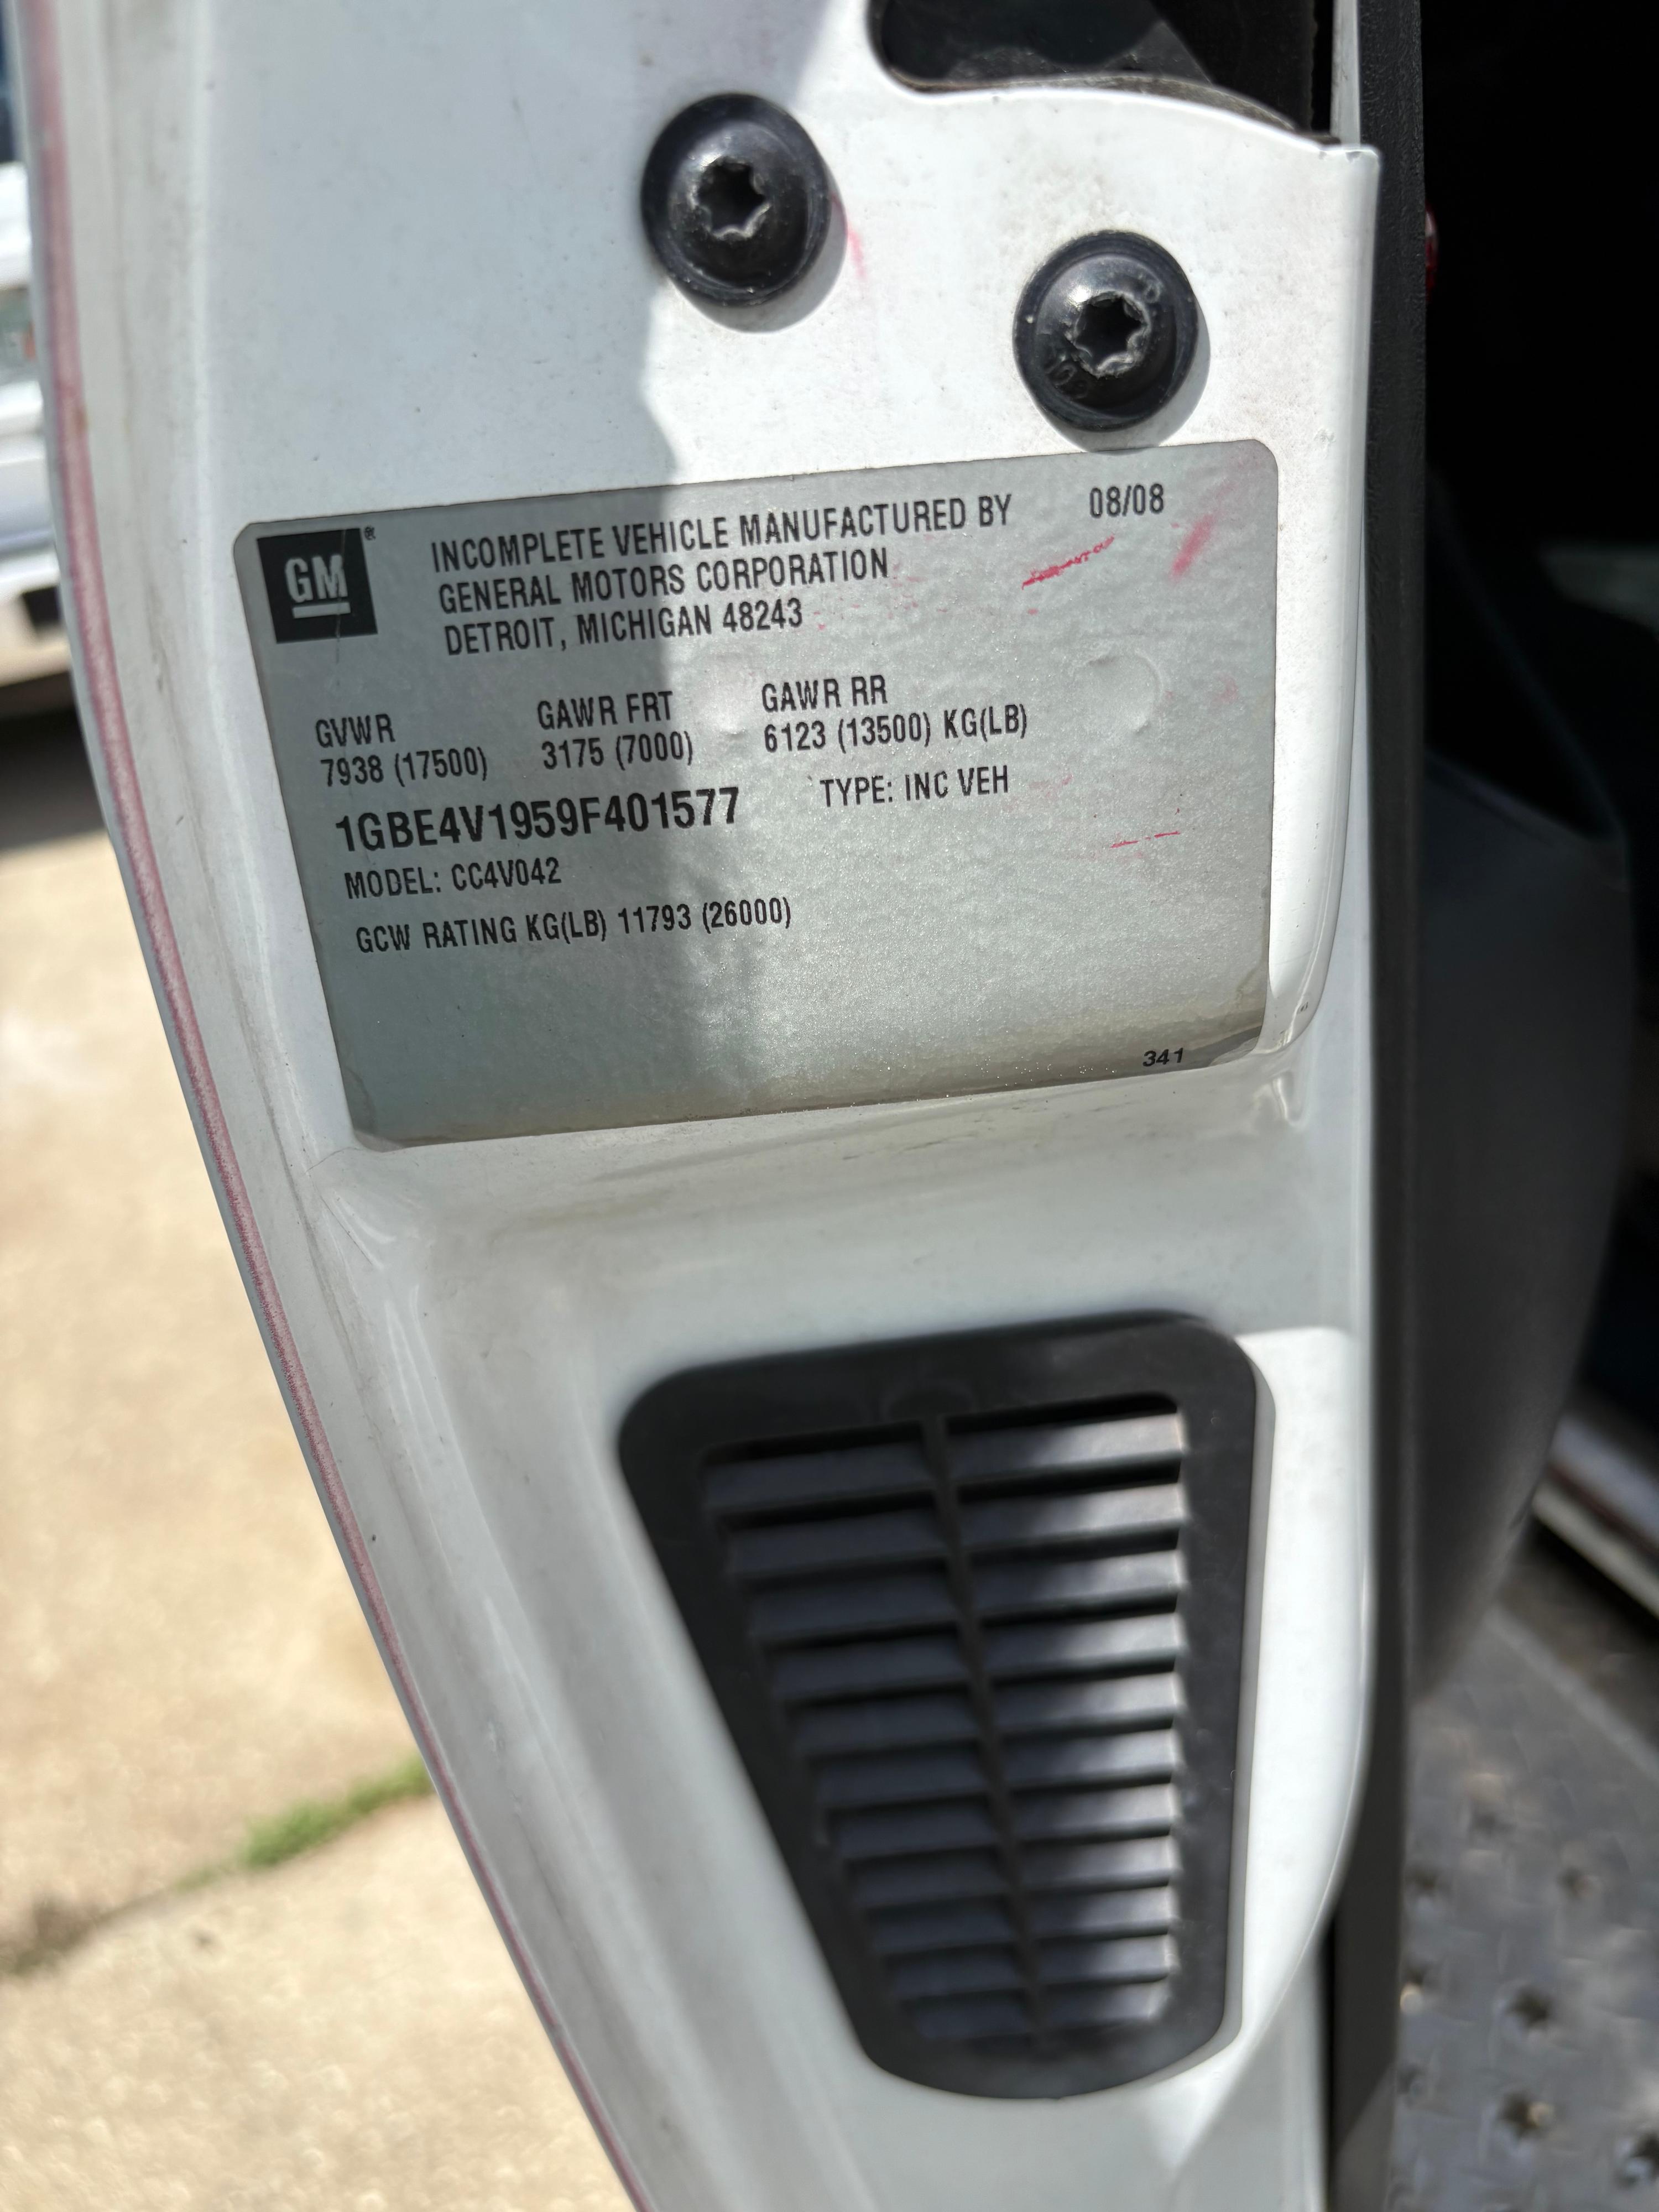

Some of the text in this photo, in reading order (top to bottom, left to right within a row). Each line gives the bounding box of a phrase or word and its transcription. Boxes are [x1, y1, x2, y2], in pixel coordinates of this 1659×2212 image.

[1089, 483, 1164, 518] 08/08
[431, 494, 1011, 572] INCOMPLETE VEHICLE MANUFACTURED BY
[439, 547, 888, 613] GENERAL MOTORS CORPORATION
[445, 597, 802, 655] DETROIT, MICHIGAN 48243
[537, 690, 672, 729] GAWR FRT
[761, 674, 888, 712] GAWR RR
[315, 713, 395, 748] GVWR
[764, 703, 1027, 754] 6123 (13500) KG(LB)
[321, 747, 487, 787] 7938 (17500)
[541, 731, 693, 770] 3175 (7000)
[820, 765, 1008, 807] TYPE: INC VEH
[336, 786, 739, 851] 1GBE4V1959F401577
[345, 857, 561, 899] MODEL: CC4V042
[356, 897, 791, 953] GCW RATING KG(LB) 11793 (26000)
[1142, 1047, 1184, 1067] 341
